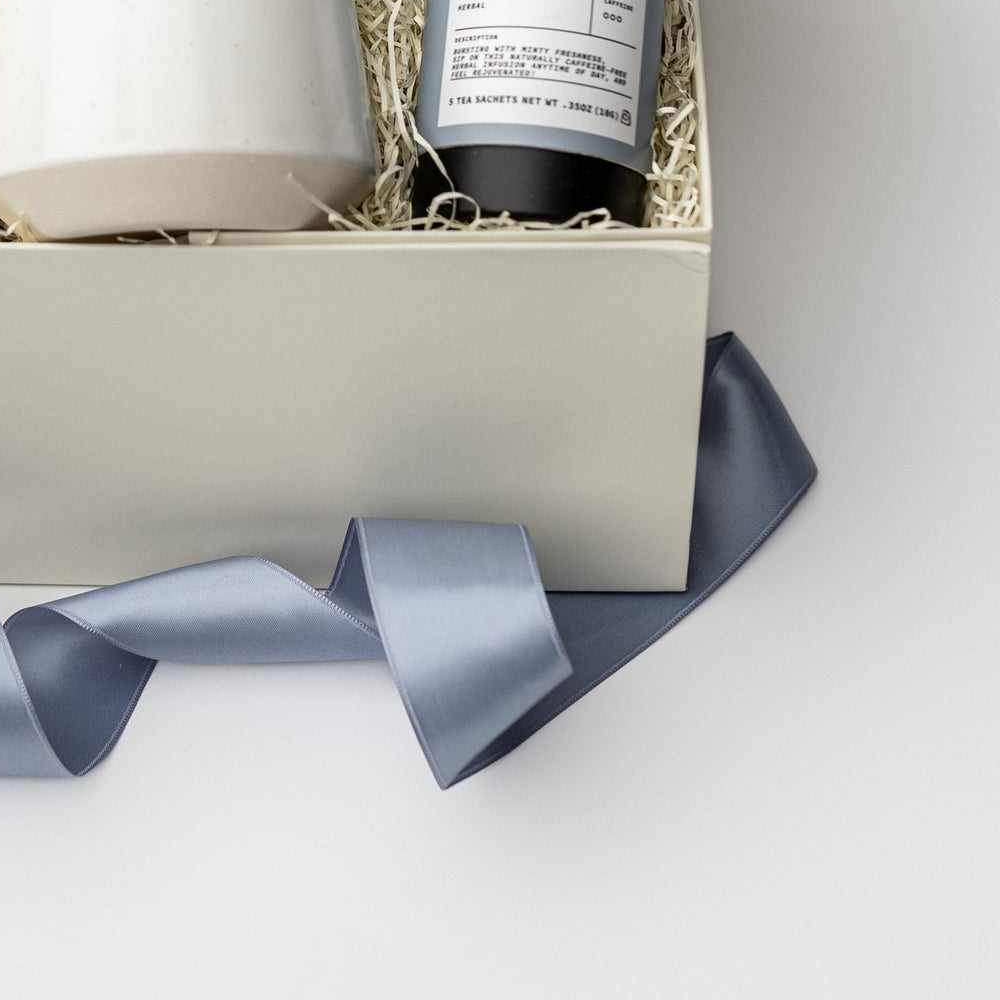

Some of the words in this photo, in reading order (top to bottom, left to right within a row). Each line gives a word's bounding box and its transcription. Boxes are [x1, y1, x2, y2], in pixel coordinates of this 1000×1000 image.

[458, 2, 486, 12] HERBAL
[455, 34, 498, 43] DESCRIPTION
[453, 46, 490, 56] BURSTING
[555, 49, 606, 65] FRESHNESS,
[452, 62, 477, 70] HERBAL
[532, 63, 570, 73] ANYTIME
[510, 54, 560, 63] NATURALLY
[565, 59, 628, 78] CAFFEINE-FREE
[449, 97, 454, 106] 5
[475, 95, 518, 104] SACHETS
[521, 97, 541, 106] NET
[545, 99, 558, 107] WT
